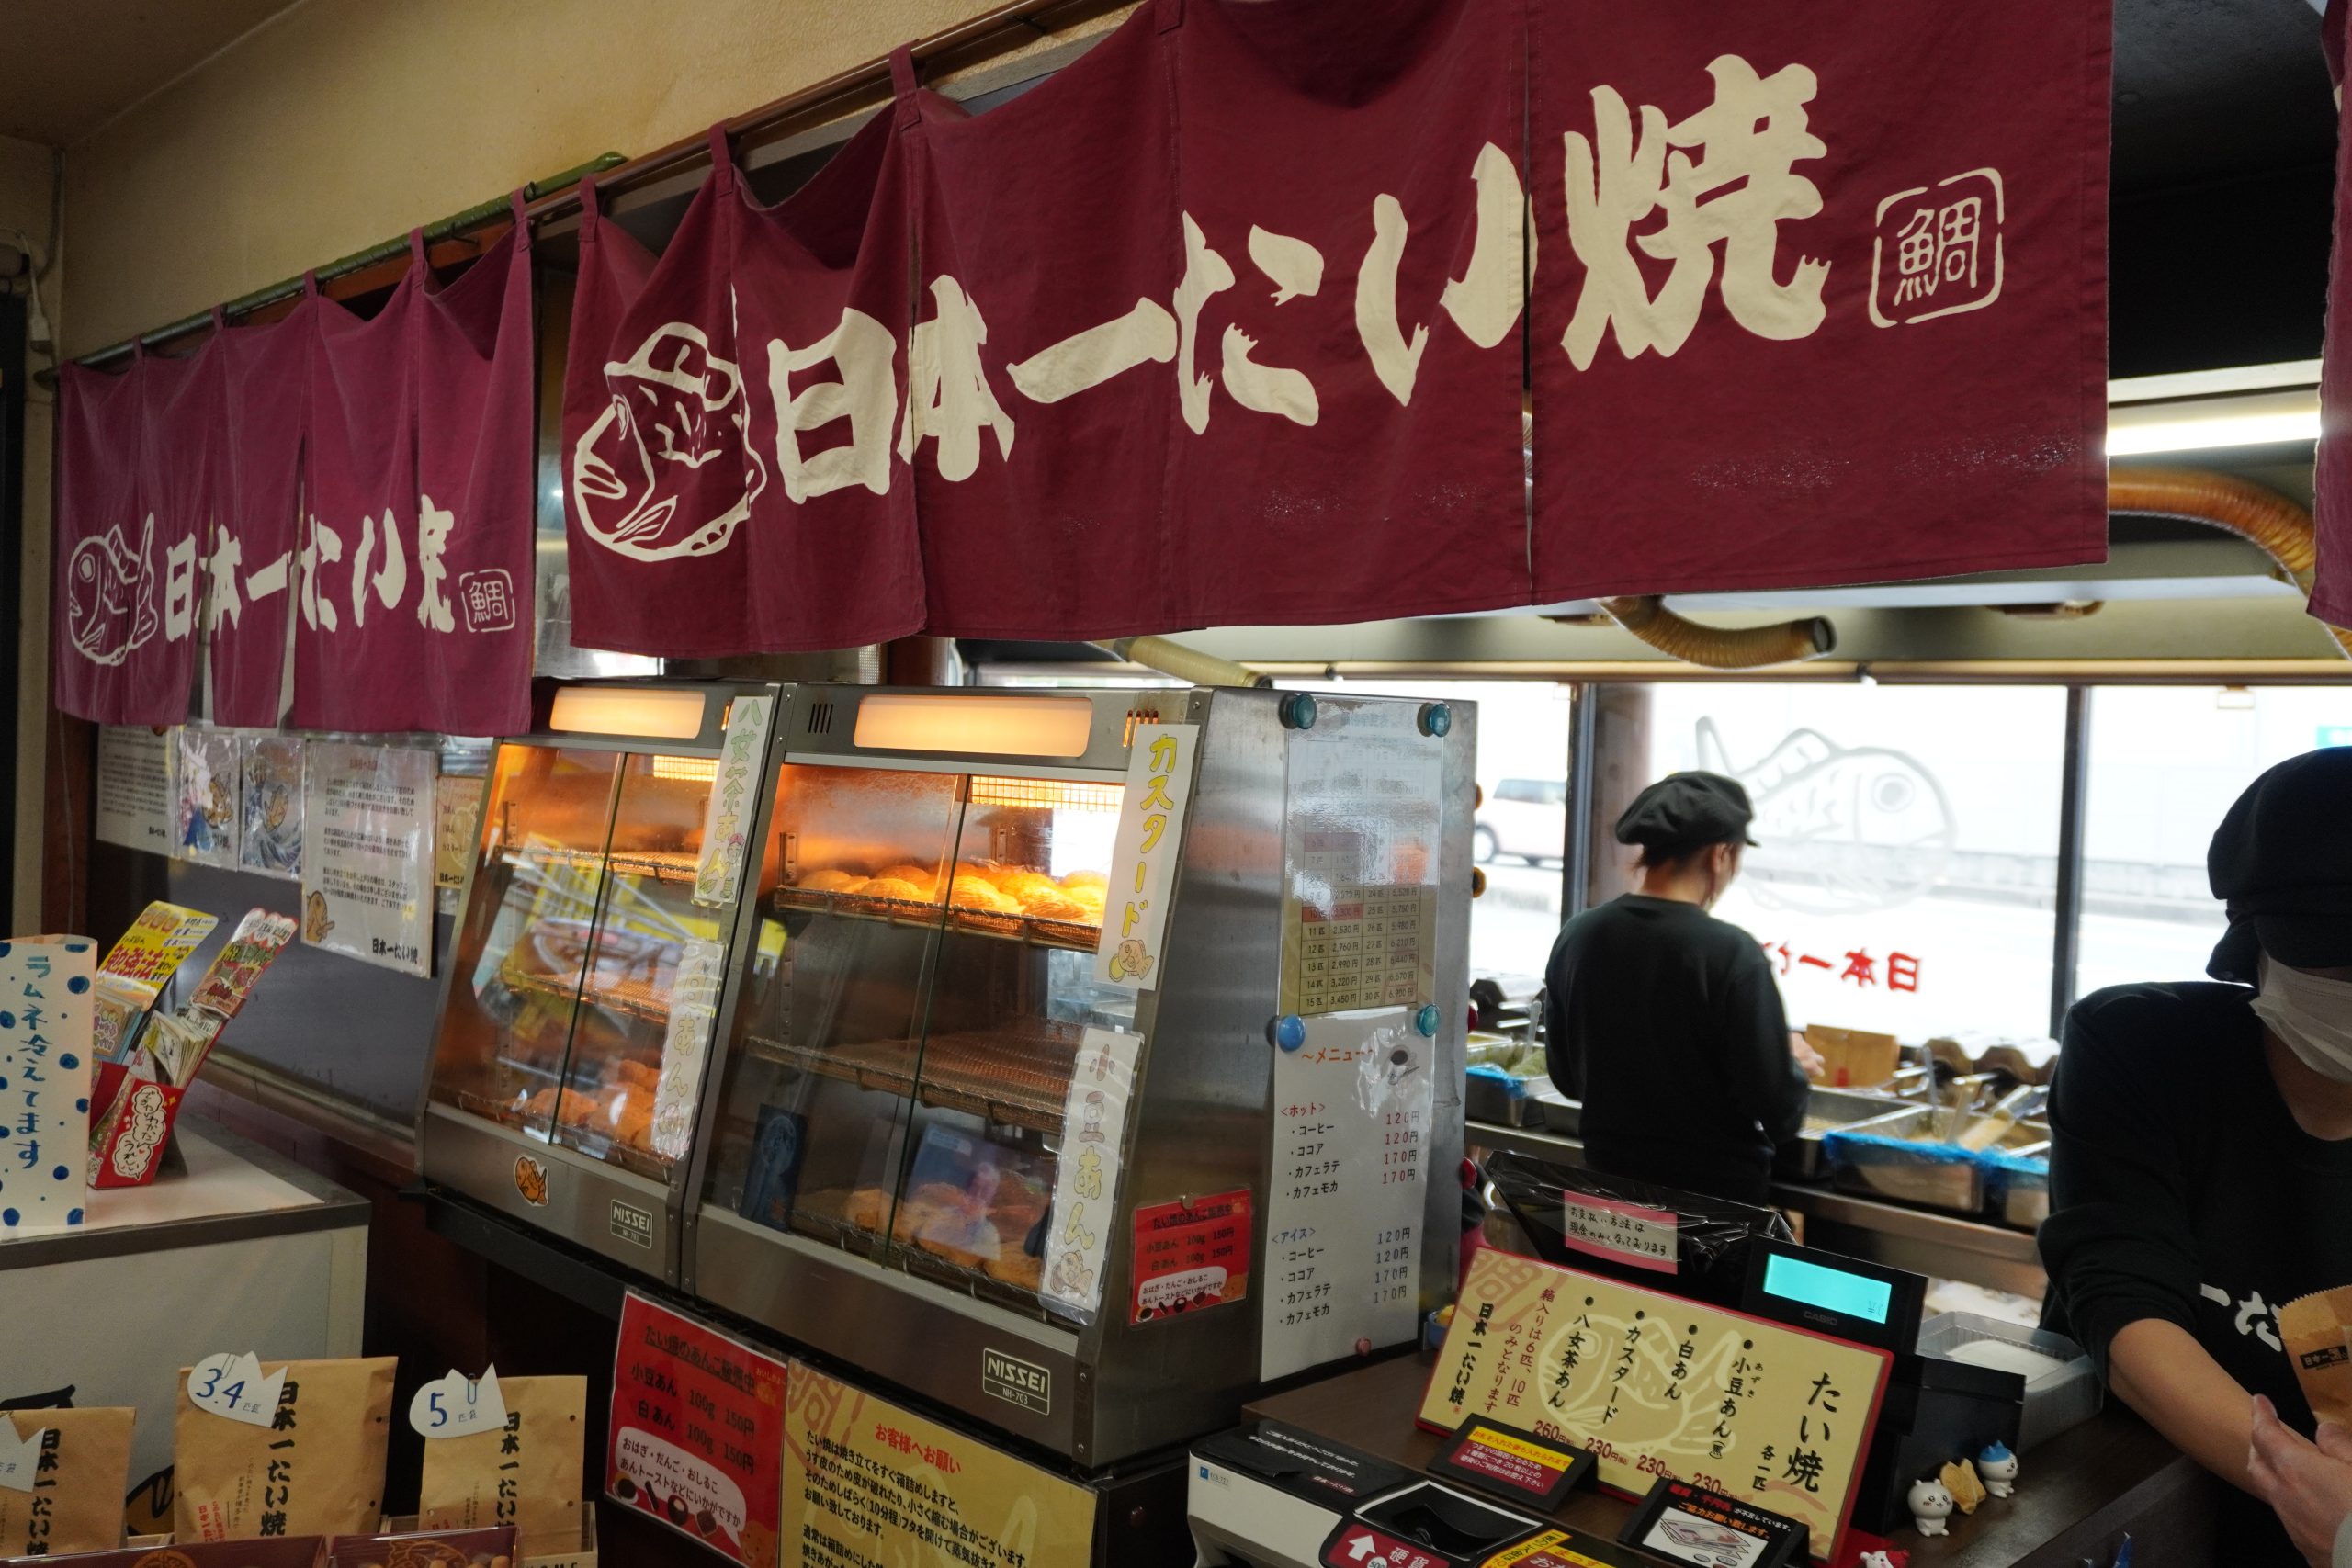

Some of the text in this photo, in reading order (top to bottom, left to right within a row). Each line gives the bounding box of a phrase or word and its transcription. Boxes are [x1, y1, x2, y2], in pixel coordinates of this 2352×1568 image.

[1893, 197, 1982, 305] 鯛
[768, 54, 1831, 503] 日本一たい焼
[1122, 733, 1178, 938] カスタード
[372, 938, 419, 964] 日本一たい焼
[665, 958, 707, 1097] 白あん
[14, 956, 52, 1169] ラムネ冷えてます
[1385, 1131, 1419, 1145] 120円
[1386, 1111, 1420, 1125] 120円
[1064, 1044, 1115, 1250] 小豆あん
[1384, 1149, 1417, 1166] 170円
[1382, 1169, 1416, 1185] 170円
[613, 1205, 650, 1232] NISSEI
[1378, 1227, 1411, 1244] 120円
[1374, 1266, 1408, 1283] 170円
[1376, 1247, 1409, 1264] 120円
[1374, 1285, 1407, 1303] 170円
[1803, 1311, 1838, 1325] CASIO
[988, 1357, 1046, 1393] NISSEI
[1448, 1303, 1495, 1406] 日本一たい焼
[1547, 1314, 1591, 1409] 八女茶あん
[1602, 1325, 1642, 1425] カスタード
[1663, 1340, 1695, 1401] 白あん
[429, 1392, 448, 1427] 5
[631, 1362, 755, 1441] 小豆あん 100g 150円
[1002, 1387, 1029, 1404] NH-703
[688, 1425, 714, 1456] 100g
[723, 1442, 755, 1475] 150円
[876, 1423, 962, 1475] お客様へお願い
[1782, 1371, 1841, 1493] たい焼
[260, 1381, 300, 1536] 日本一たい焼
[495, 1411, 522, 1528] 日本一たい
[1752, 1445, 1776, 1492] 各一匹
[804, 1487, 886, 1540] お願い致しております。
